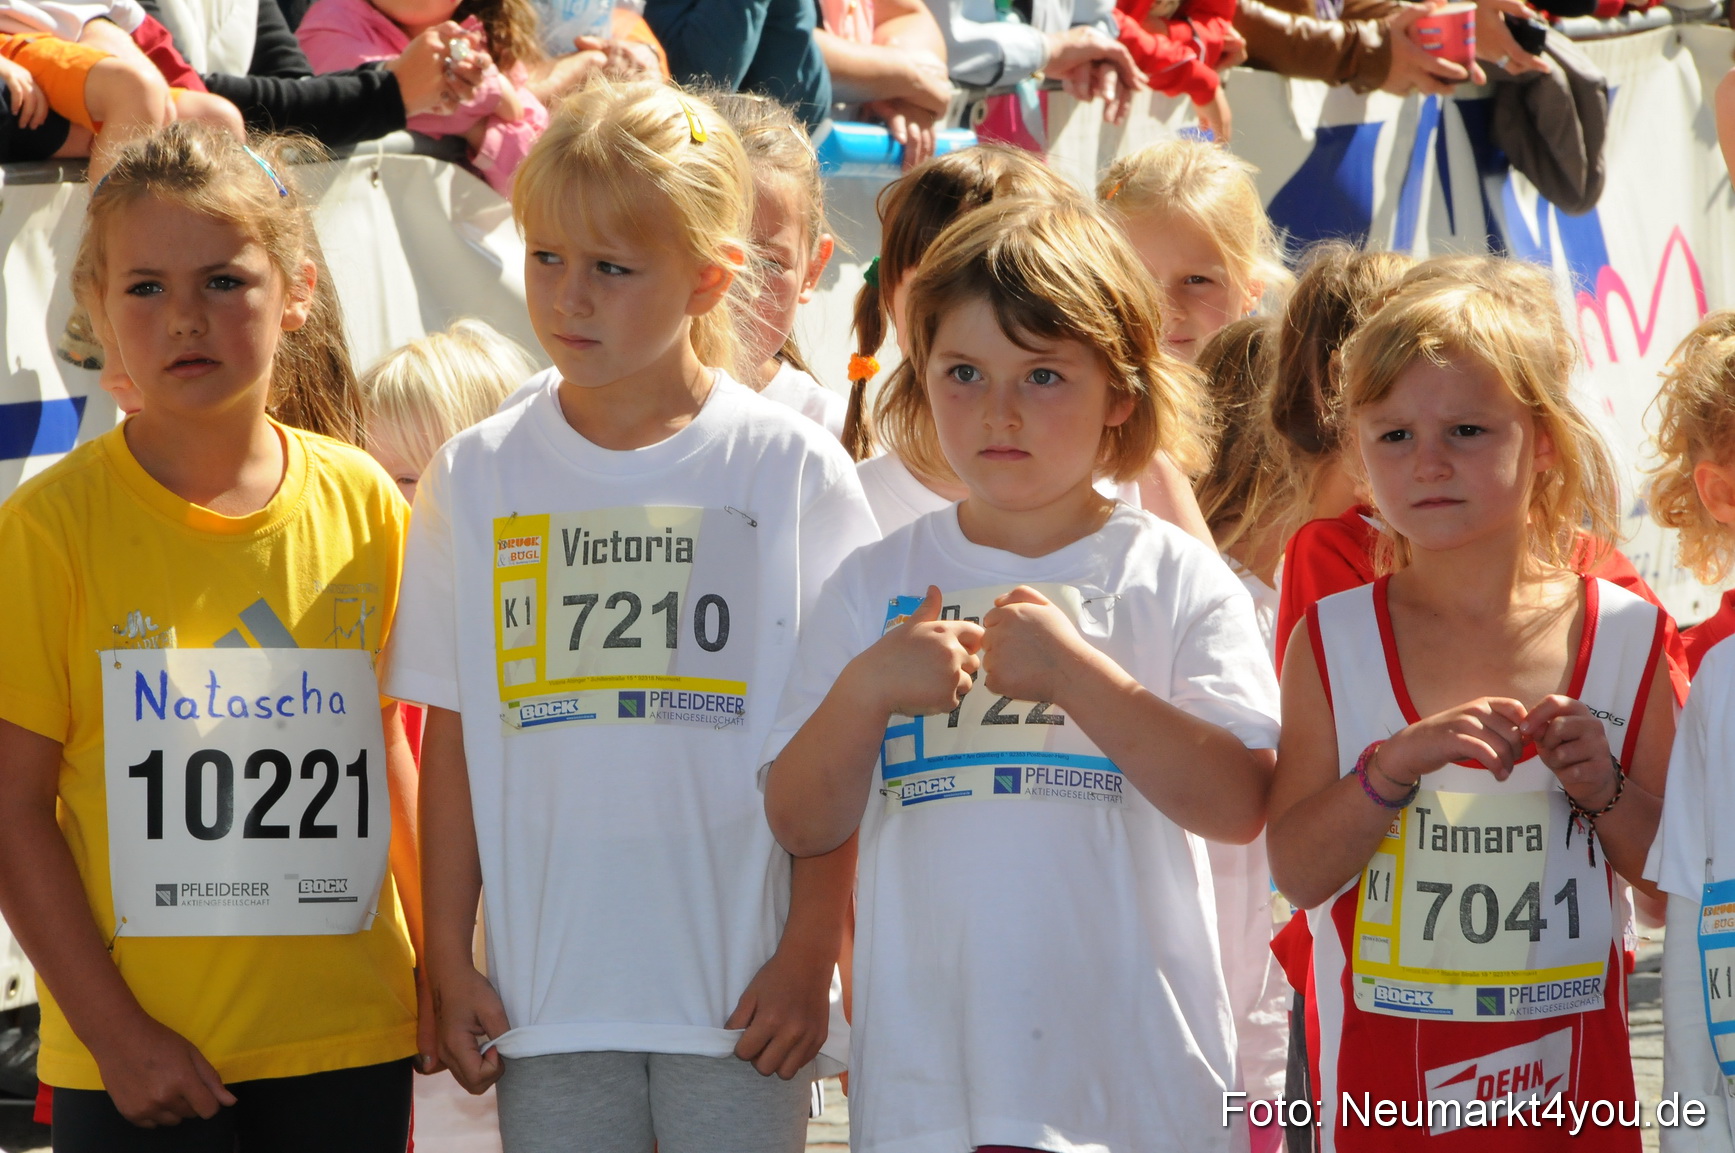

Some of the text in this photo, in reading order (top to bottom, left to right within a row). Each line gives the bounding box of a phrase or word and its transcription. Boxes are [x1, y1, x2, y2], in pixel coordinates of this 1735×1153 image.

[561, 527, 693, 567] Victoria
[505, 596, 531, 628] K 1
[563, 591, 730, 652] 7210
[135, 669, 346, 722] Natascha
[650, 691, 744, 714] PFLEIDERER
[520, 699, 579, 720] BOCK
[649, 710, 745, 726] AKTIENGESELLSCHAFT
[901, 776, 956, 799] BOCK
[1025, 767, 1123, 793] PFLEIDERER
[128, 748, 368, 841] 10221
[1025, 786, 1123, 804] AKTIENGESELLSCHAFT
[1415, 807, 1543, 853] Tamara
[181, 882, 270, 897] PFLEIDERER
[299, 878, 348, 893] BOCK
[1368, 869, 1390, 902] K 1
[181, 898, 270, 907] AKTIENGESELLSCHAFT
[1416, 878, 1581, 944] 7041
[1714, 917, 1735, 929] BÖG
[1375, 985, 1434, 1006] BOCK
[1509, 977, 1602, 1004] PFLEIDERER
[1709, 966, 1732, 1000] K 1
[1509, 994, 1602, 1015] AKTIENGESELLSCHAFT
[1476, 1059, 1544, 1101] DEHN
